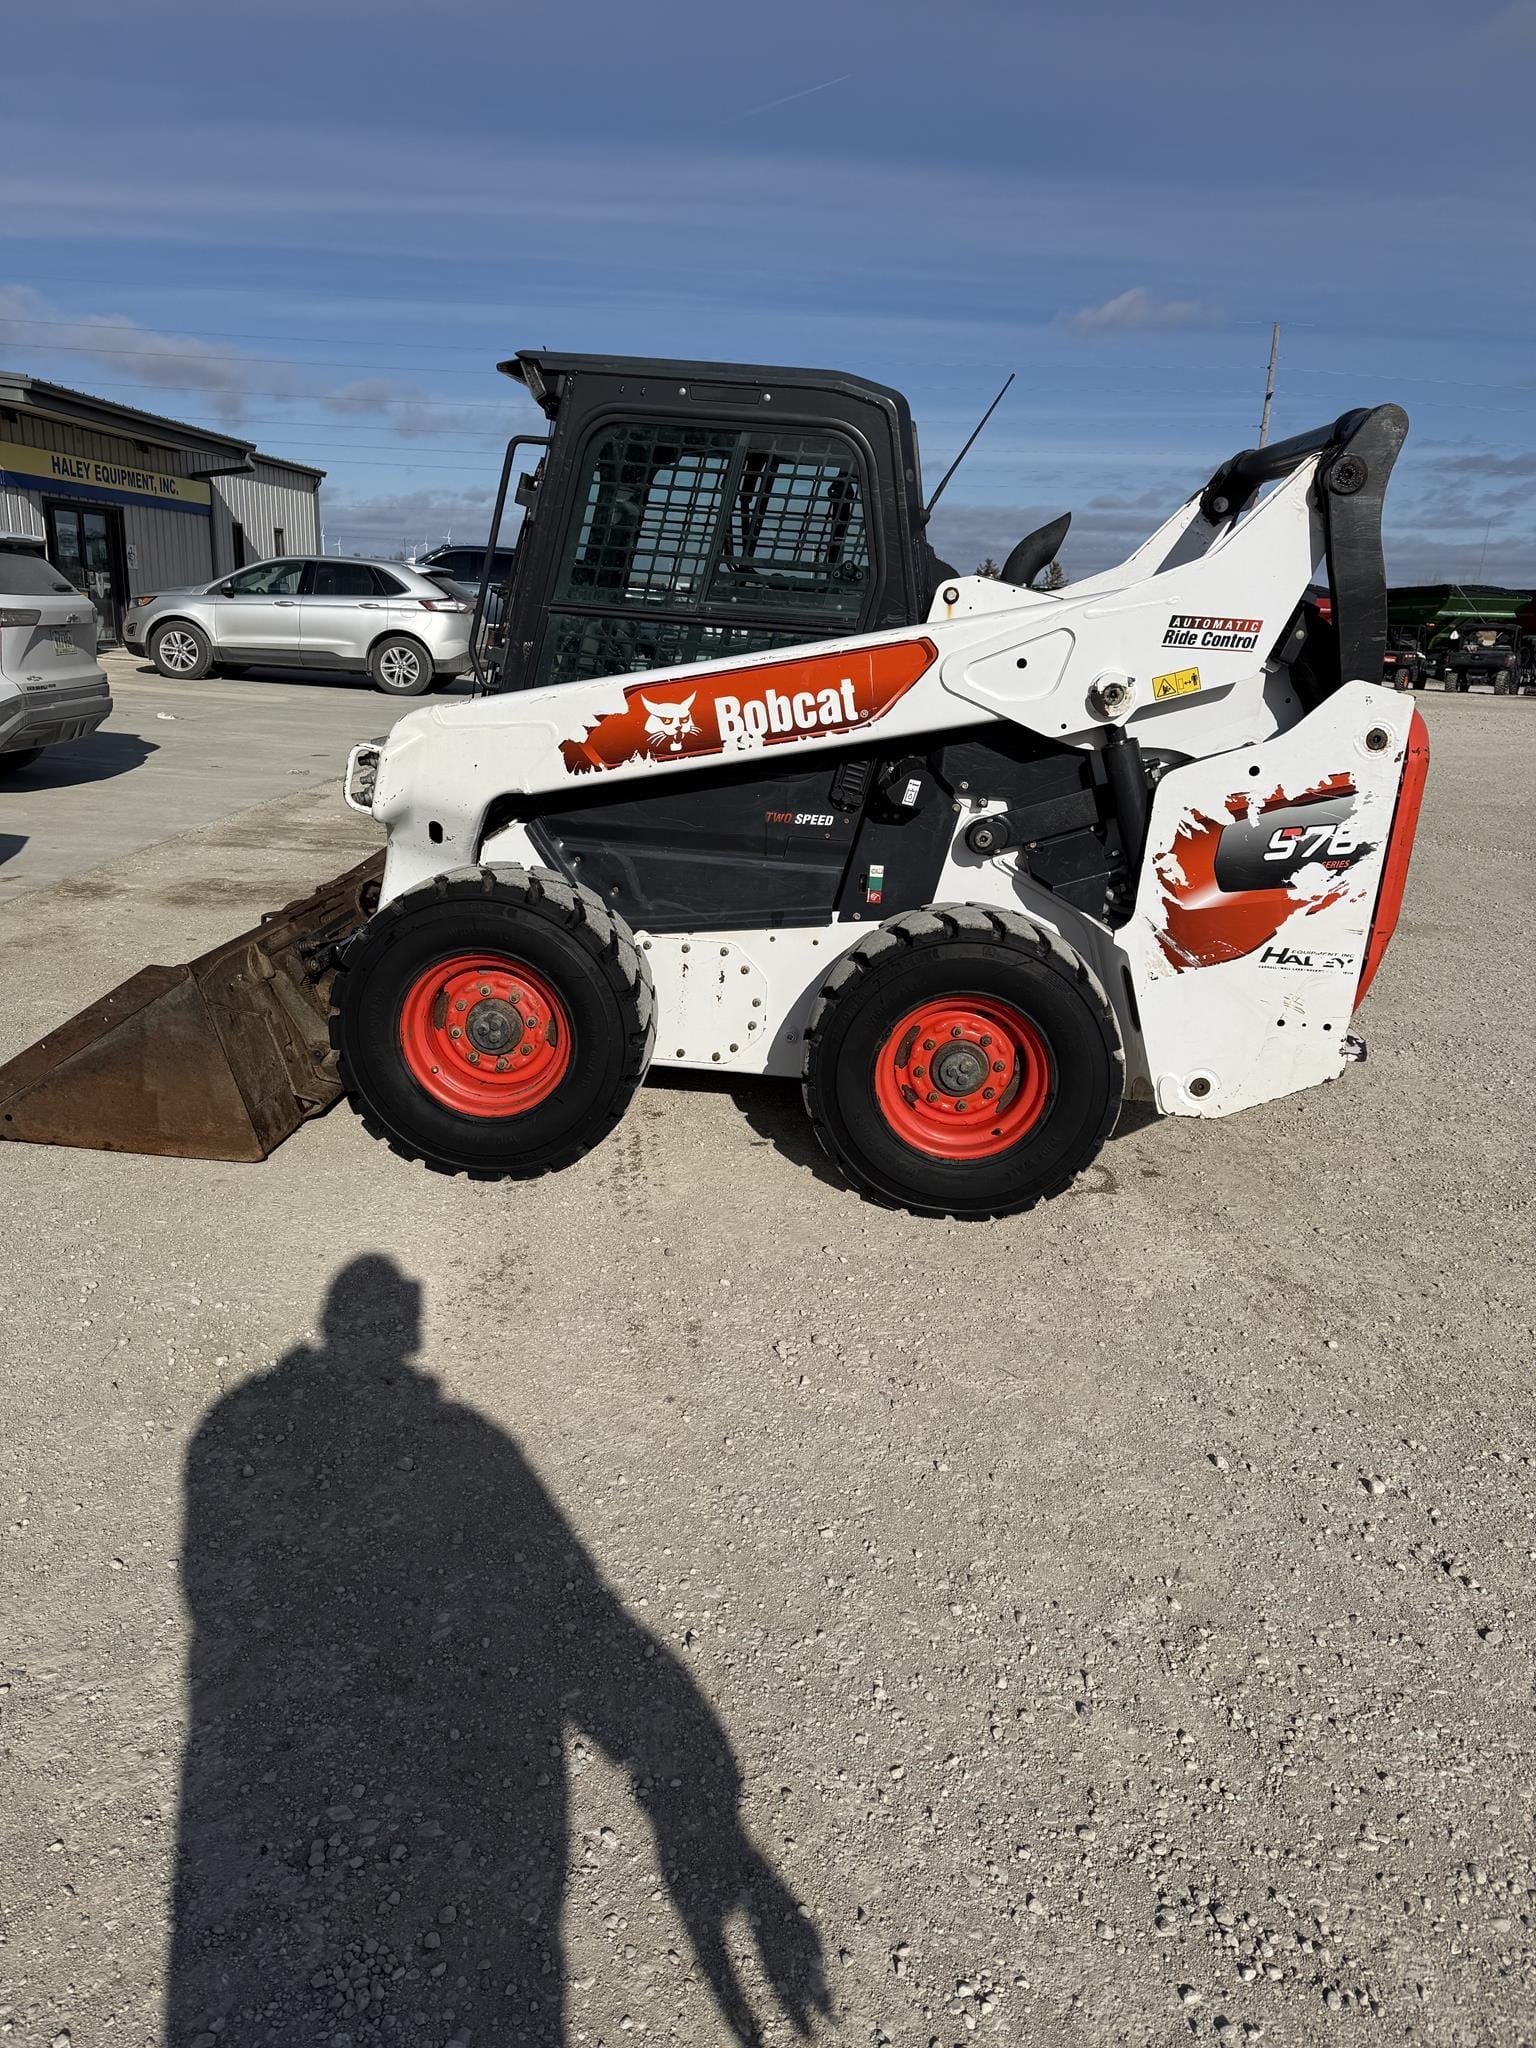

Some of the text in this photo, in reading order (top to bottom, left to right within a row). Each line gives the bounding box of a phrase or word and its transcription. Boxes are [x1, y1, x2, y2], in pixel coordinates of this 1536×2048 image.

[51, 456, 179, 495] HALEY EQUIPMENT, INC.
[1172, 617, 1259, 632] AUTOMATIC
[1162, 629, 1259, 649] Ride Control
[714, 678, 858, 742] Bobcat
[766, 811, 834, 826] TWO SPEED
[1321, 859, 1350, 869] SERIES
